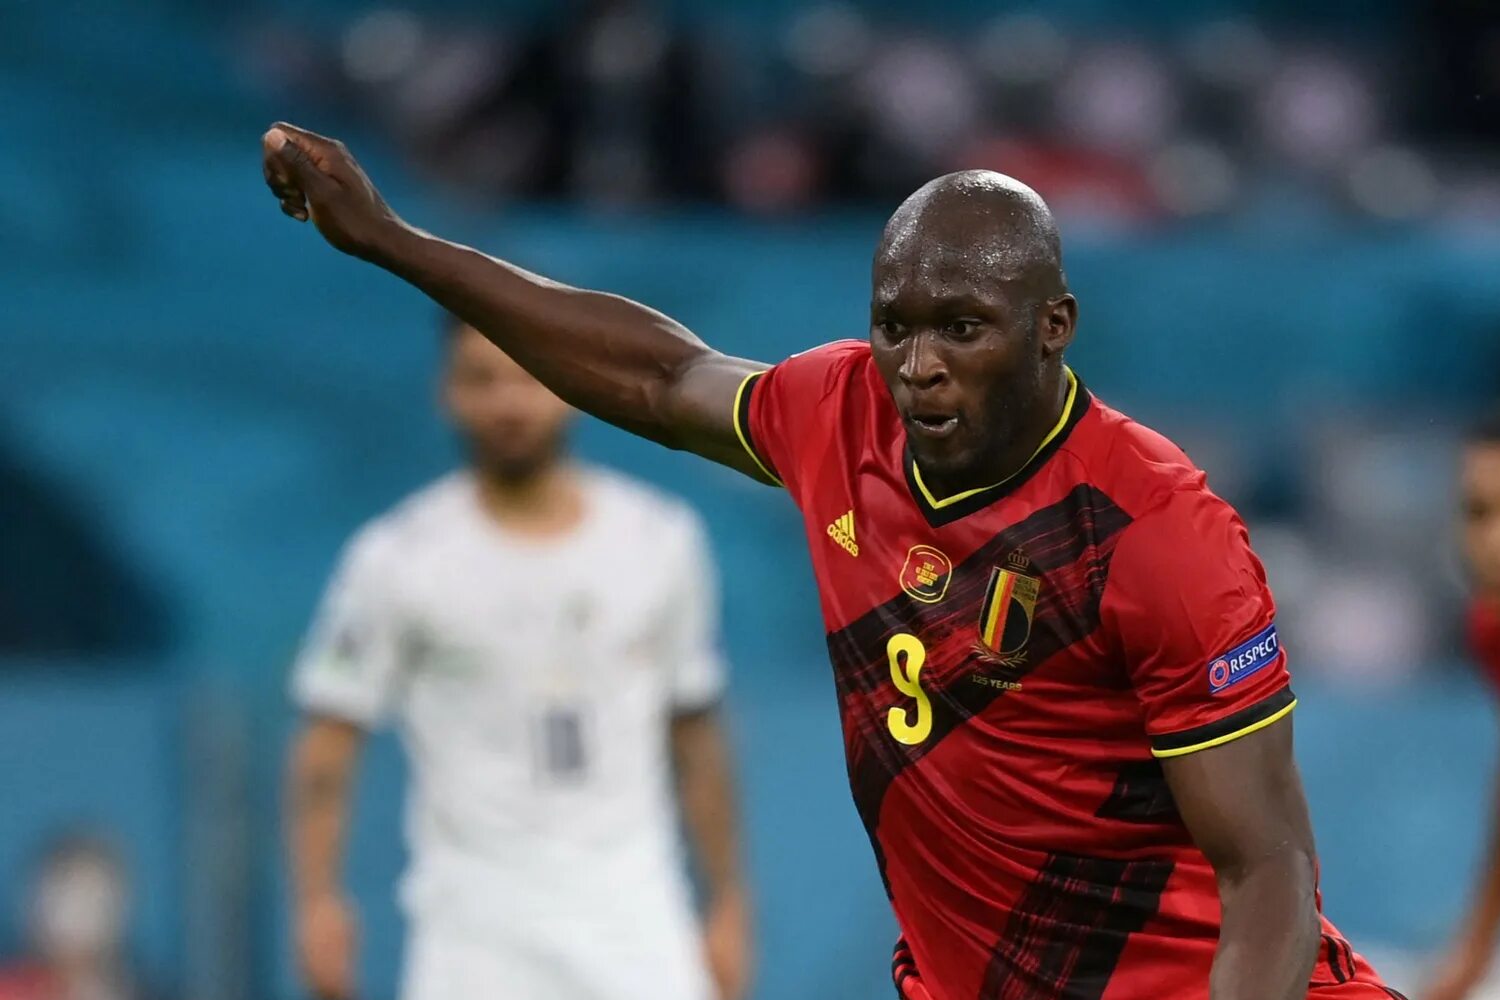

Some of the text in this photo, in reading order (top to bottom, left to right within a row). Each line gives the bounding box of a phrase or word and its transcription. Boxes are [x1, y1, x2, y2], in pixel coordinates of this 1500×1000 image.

[827, 523, 859, 557] adidas
[1230, 632, 1277, 674] RESPECT
[886, 633, 932, 745] 9
[990, 679, 1022, 691] YEARS
